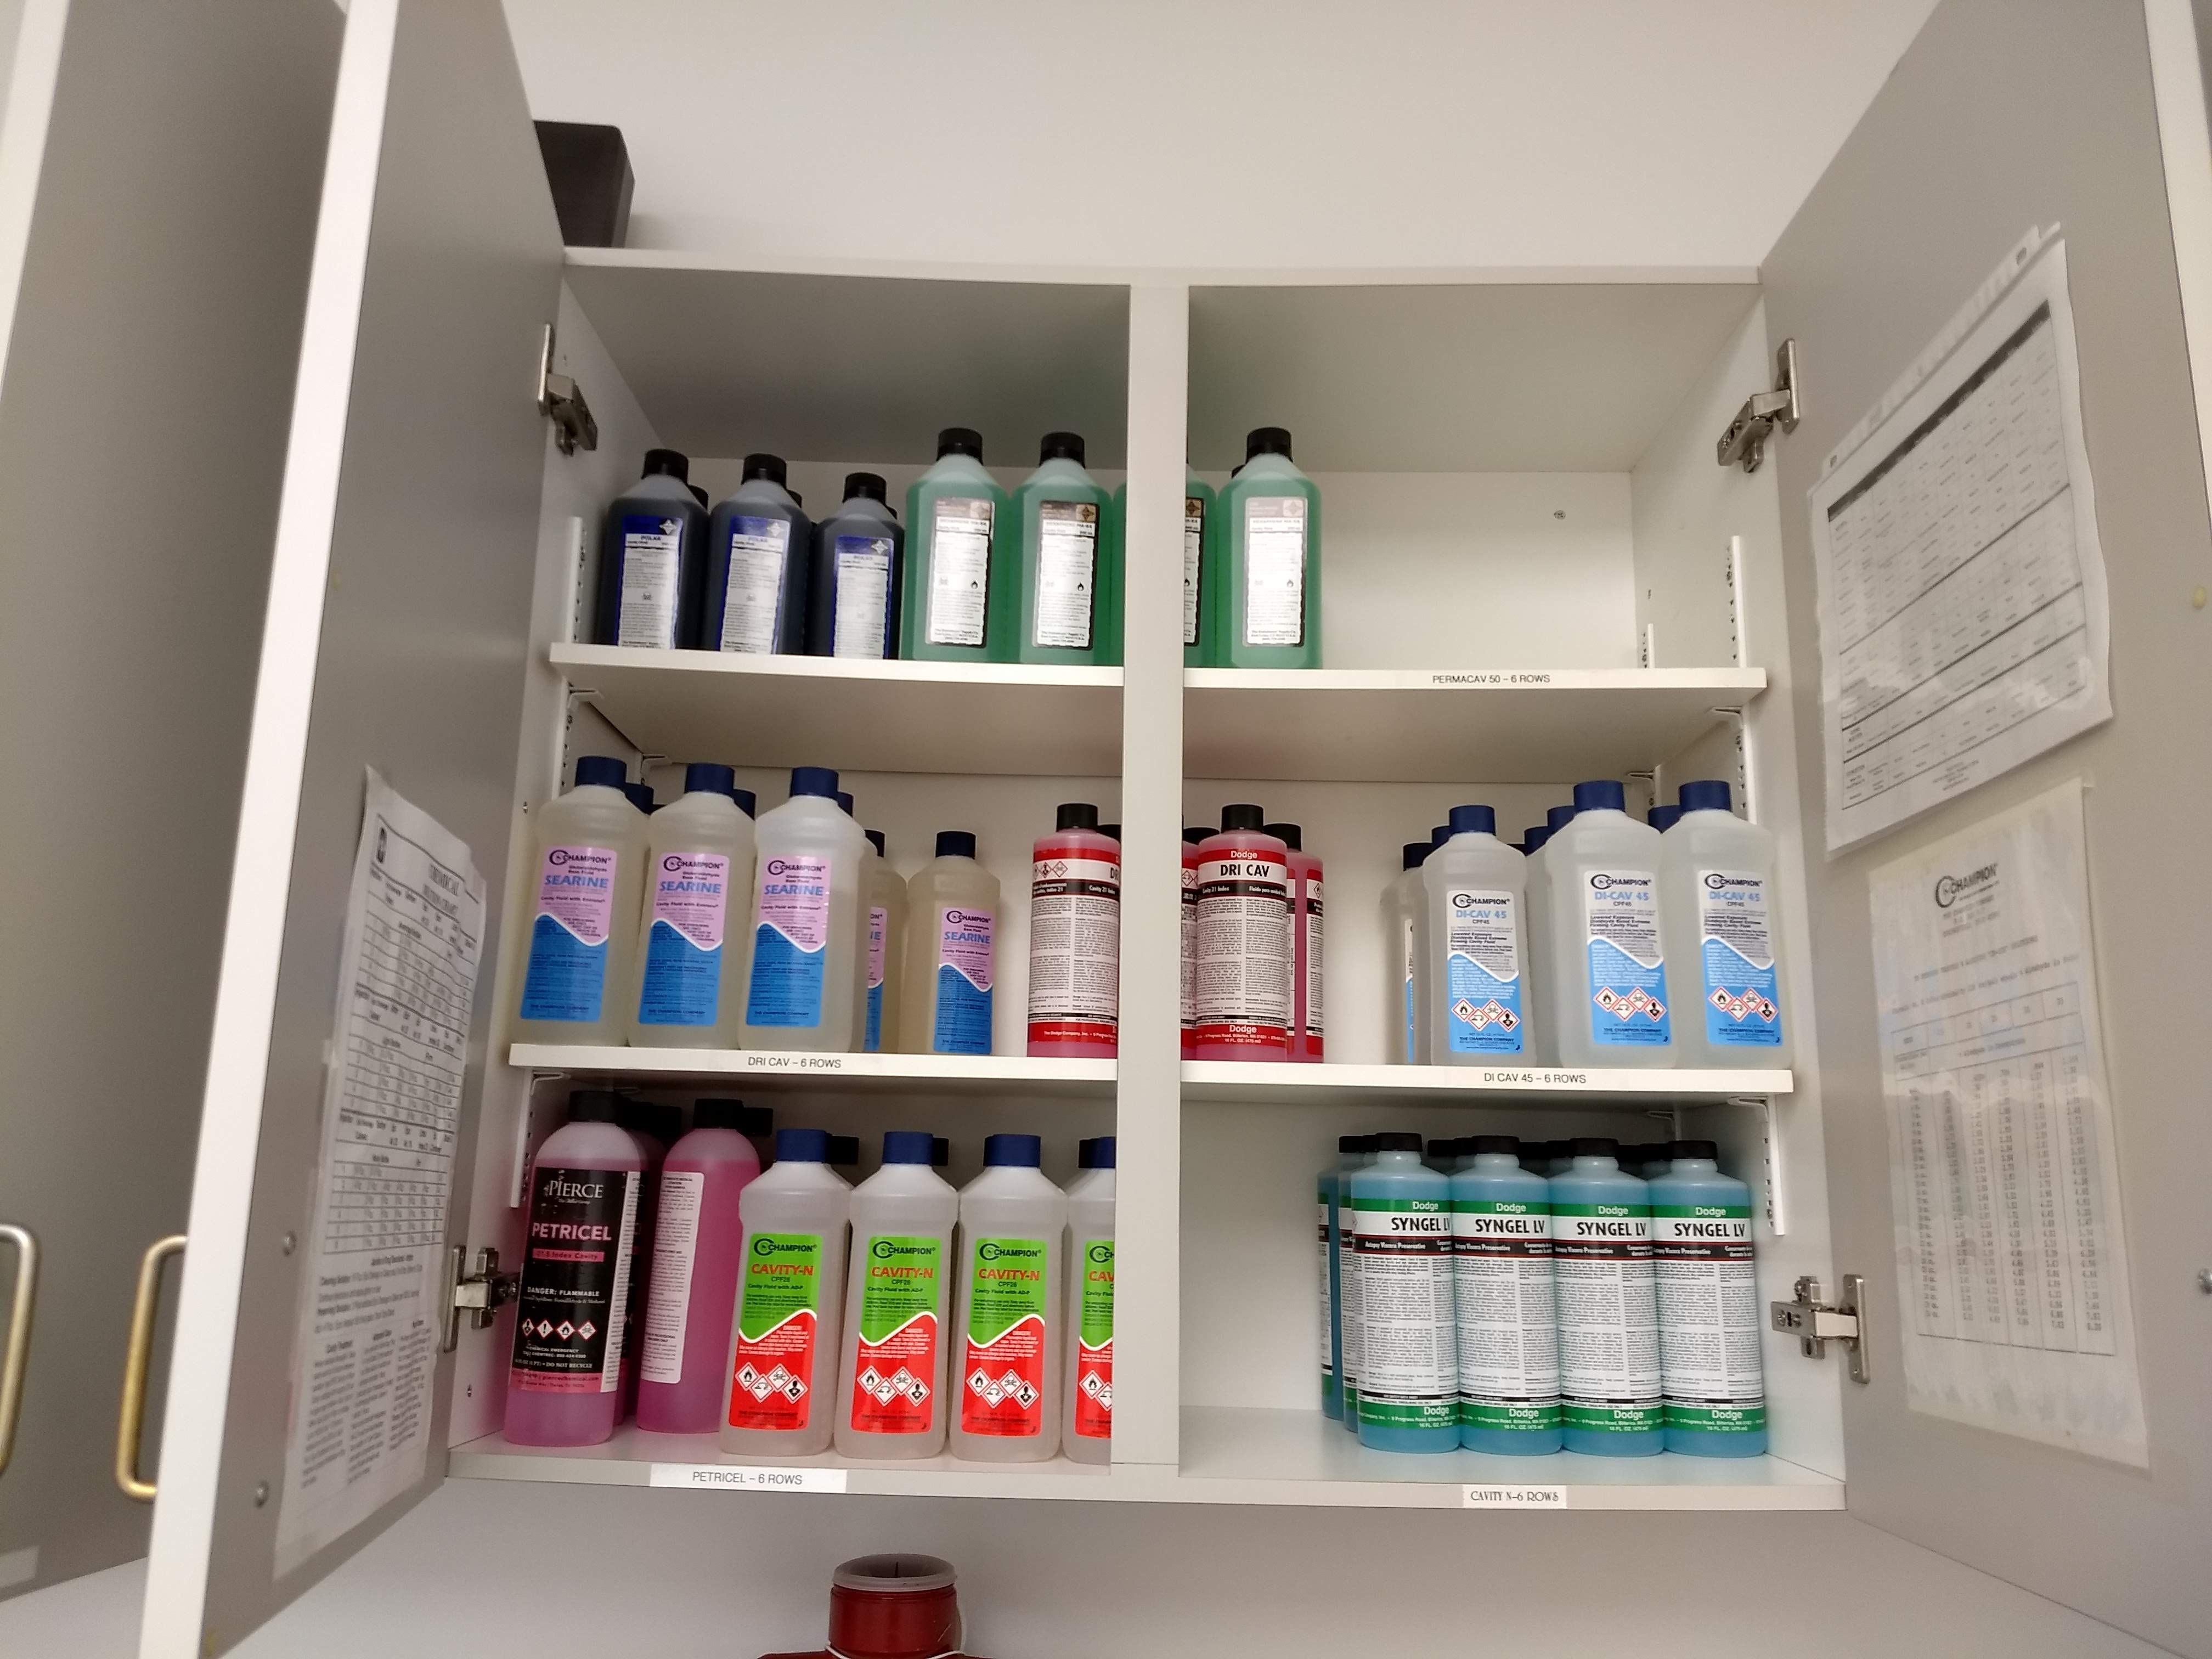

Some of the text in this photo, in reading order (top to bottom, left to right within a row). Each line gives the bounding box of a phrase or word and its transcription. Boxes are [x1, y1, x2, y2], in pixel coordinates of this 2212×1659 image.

[1432, 675, 1486, 684] PERMACAV
[1489, 675, 1500, 683] 50
[1511, 675, 1516, 683] 6
[1520, 675, 1550, 683] ROWS
[1231, 850, 1257, 860] Dodge
[1220, 864, 1270, 877] DRI CAV
[545, 875, 608, 888] SEARINE
[659, 881, 721, 894] SEARINE
[764, 884, 824, 896] SEARINE
[1595, 891, 1649, 901] DI-CAV 45
[1710, 891, 1760, 901] DI-CAV 45
[1456, 910, 1507, 918] DI-CAV 45
[944, 931, 990, 944] SEARINE
[1229, 1025, 1257, 1034] Dodge
[748, 1057, 766, 1066] DRI
[769, 1058, 790, 1066] CAV
[800, 1058, 806, 1067] 6
[810, 1059, 842, 1068] ROWS
[1485, 1073, 1494, 1081] DI
[1497, 1073, 1519, 1082] CAV
[1521, 1074, 1533, 1082] 45
[1544, 1074, 1551, 1083] 6
[1554, 1074, 1587, 1084] ROWS
[549, 1180, 603, 1198] PIERCE
[1412, 1201, 1438, 1211] Dodge
[1496, 1203, 1526, 1213] Dodge
[1598, 1206, 1628, 1216] Dodge
[1695, 1207, 1726, 1217] Dodge
[1391, 1217, 1441, 1231] SYNGEL
[1475, 1219, 1544, 1233] SYNGEL LV
[1577, 1222, 1646, 1236] SYNGEL LV
[532, 1222, 612, 1241] PETRICEL
[1674, 1223, 1745, 1237] SYNGEL LV
[752, 1263, 814, 1276] CAVITY-N
[871, 1266, 933, 1278] CAVITY-N
[978, 1268, 1040, 1281] CAVITY-N
[527, 1286, 557, 1295] DANGER:
[1424, 1406, 1449, 1417] Dodge
[1509, 1408, 1539, 1419] Dodge
[1613, 1410, 1644, 1420] Dodge
[1712, 1410, 1742, 1420] Dodge
[692, 1471, 746, 1483] PETRICEL
[758, 1474, 765, 1483] 6
[768, 1474, 803, 1486] ROWS
[1470, 1491, 1503, 1501] CAVITY
[1527, 1492, 1559, 1502] ROWS
